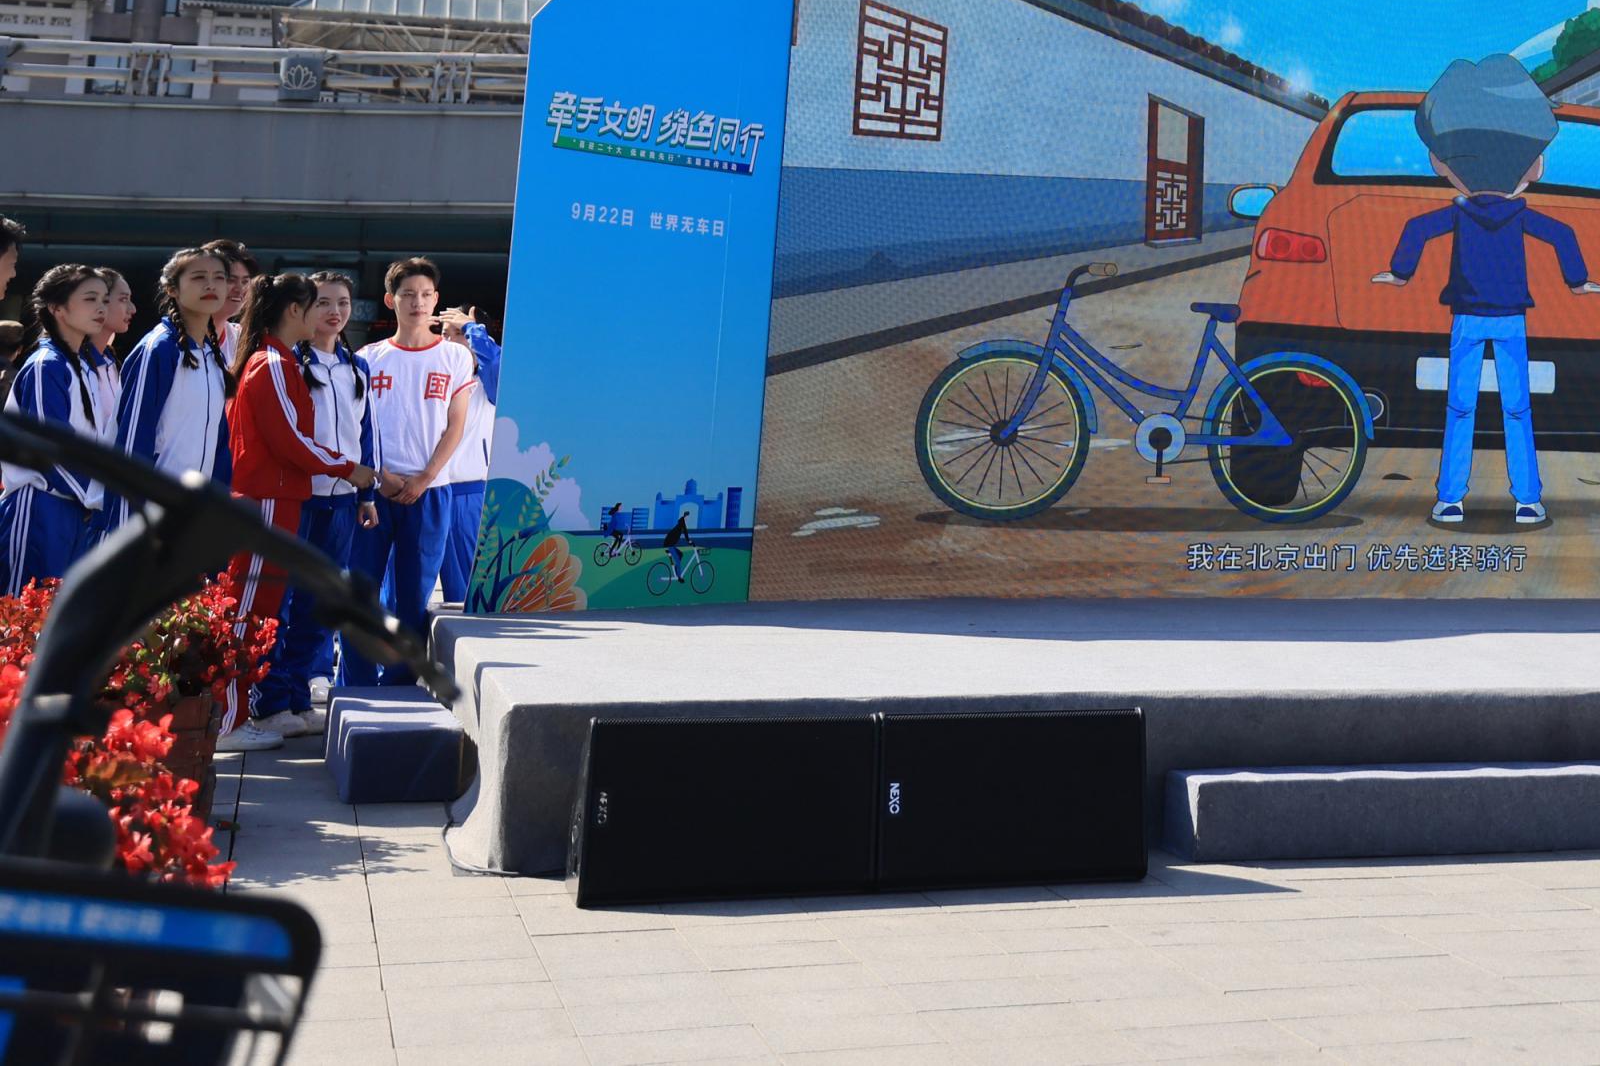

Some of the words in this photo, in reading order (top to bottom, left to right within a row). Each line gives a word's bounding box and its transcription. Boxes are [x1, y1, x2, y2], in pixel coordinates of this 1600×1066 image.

[547, 91, 656, 144] 牵手文明
[656, 107, 765, 173] 绿色同行
[571, 202, 635, 227] 9月22日
[649, 212, 725, 237] 世界无车日
[1186, 543, 1356, 572] 我在北京出门
[1366, 543, 1527, 572] 优先选择骑行
[888, 783, 901, 815] NEXO
